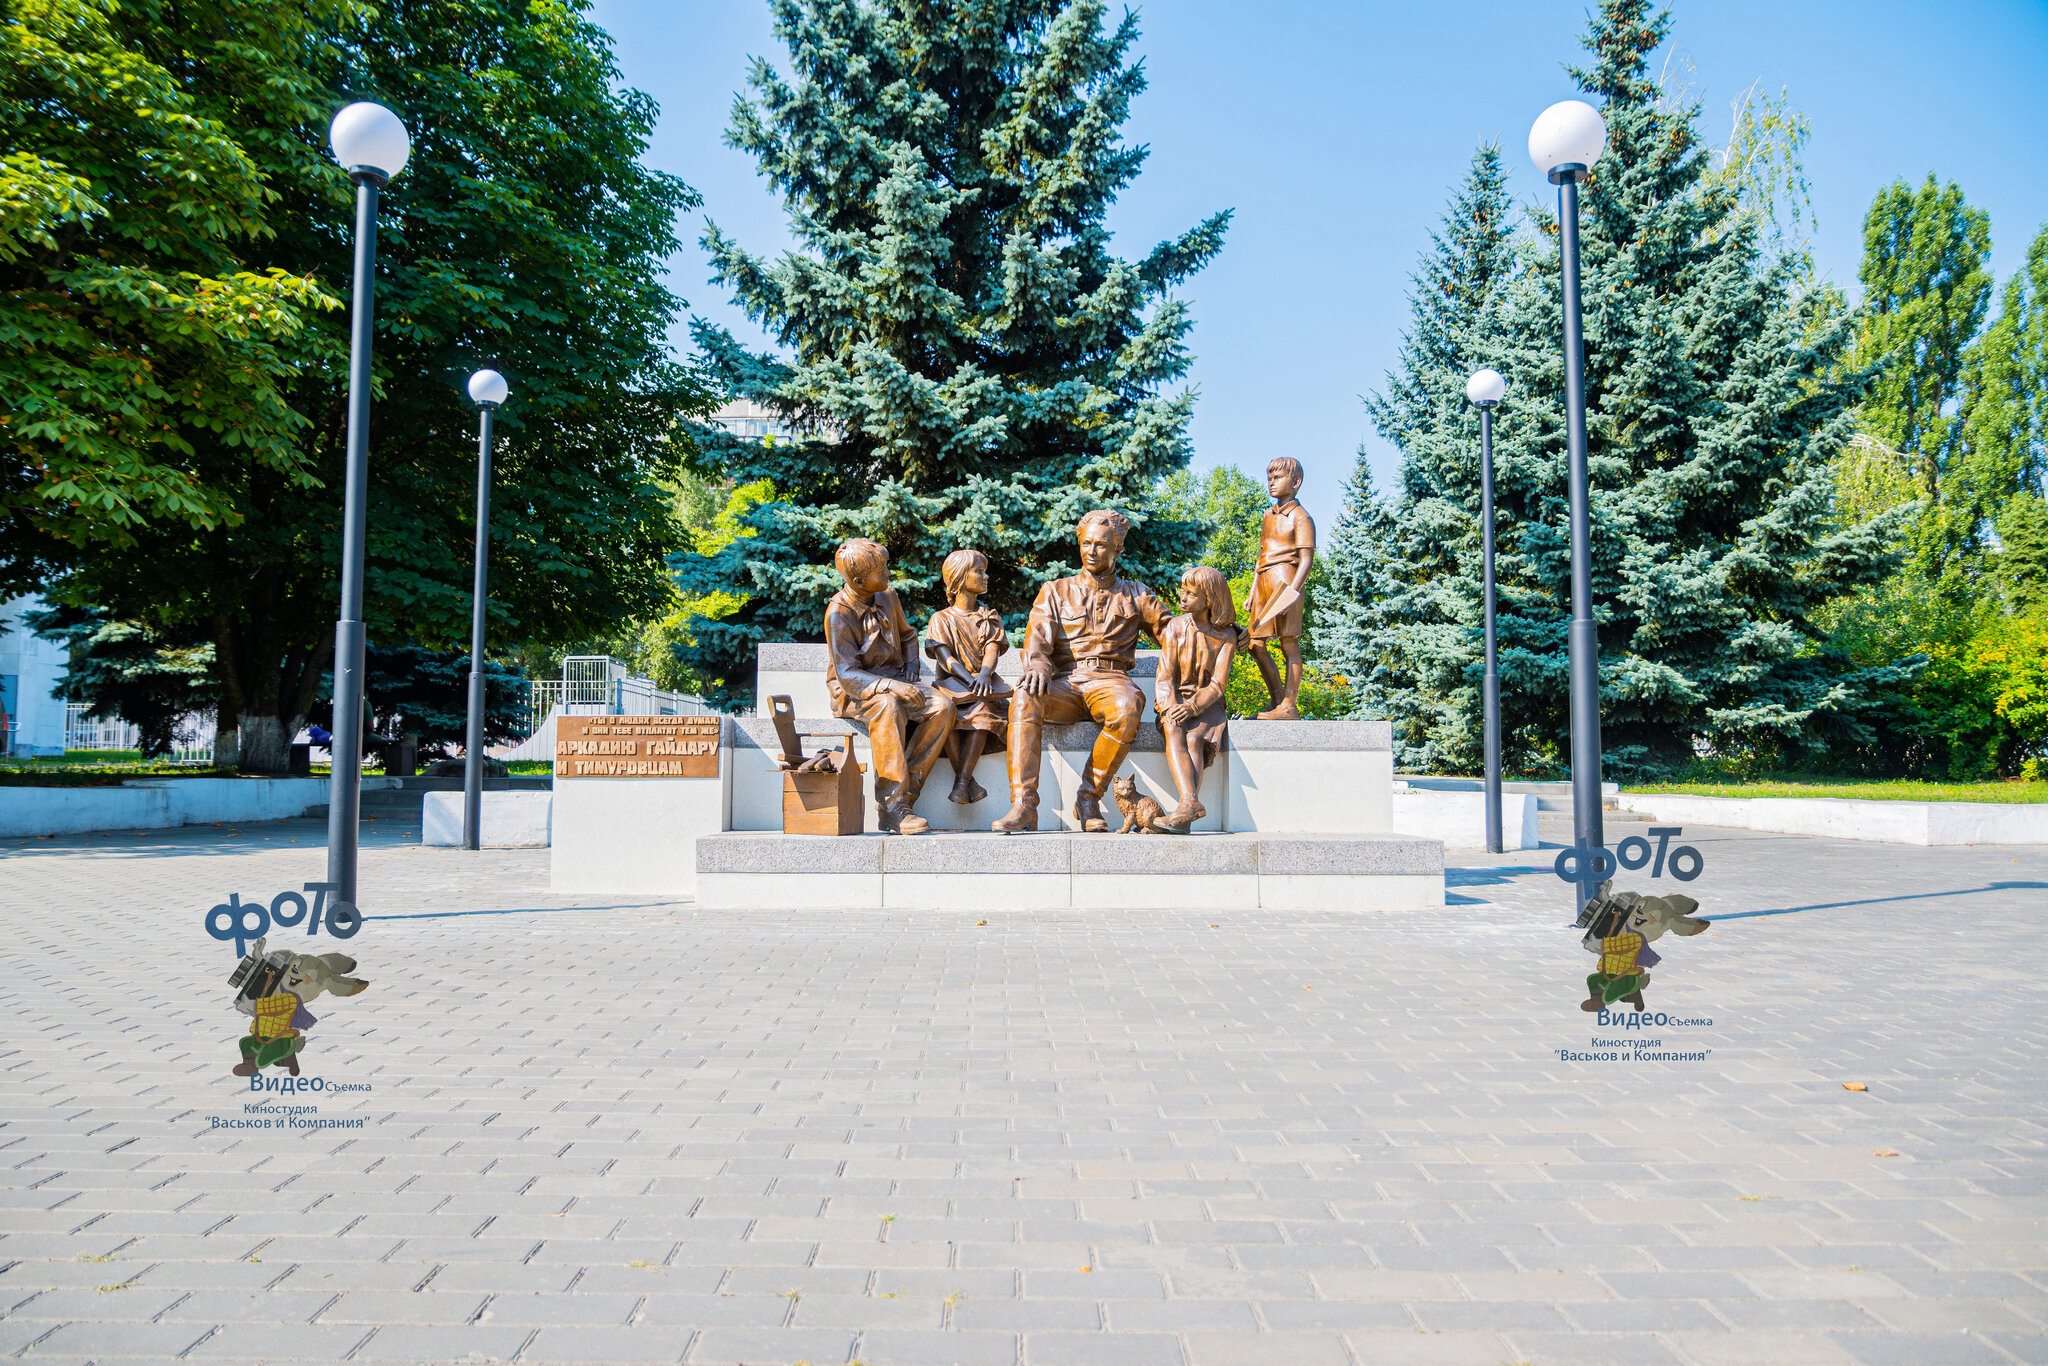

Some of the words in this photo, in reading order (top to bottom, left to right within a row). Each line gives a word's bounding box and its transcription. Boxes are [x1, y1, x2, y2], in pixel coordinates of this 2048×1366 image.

[610, 716, 616, 725] О
[619, 716, 650, 725] ЛЮДЯХ
[653, 716, 684, 725] ВСЕГДА
[582, 726, 589, 736] И
[592, 726, 609, 736] ОНИ
[612, 726, 632, 736] ТЕБЕ
[636, 726, 677, 736] ОТПЛАТЯТ
[681, 726, 698, 736] ТЕМ
[558, 740, 638, 756] АРКАДИЮ
[646, 737, 719, 756] ГАЙДАРУ
[557, 761, 568, 775] И
[575, 761, 683, 775] ТИМУРОВЦАМ
